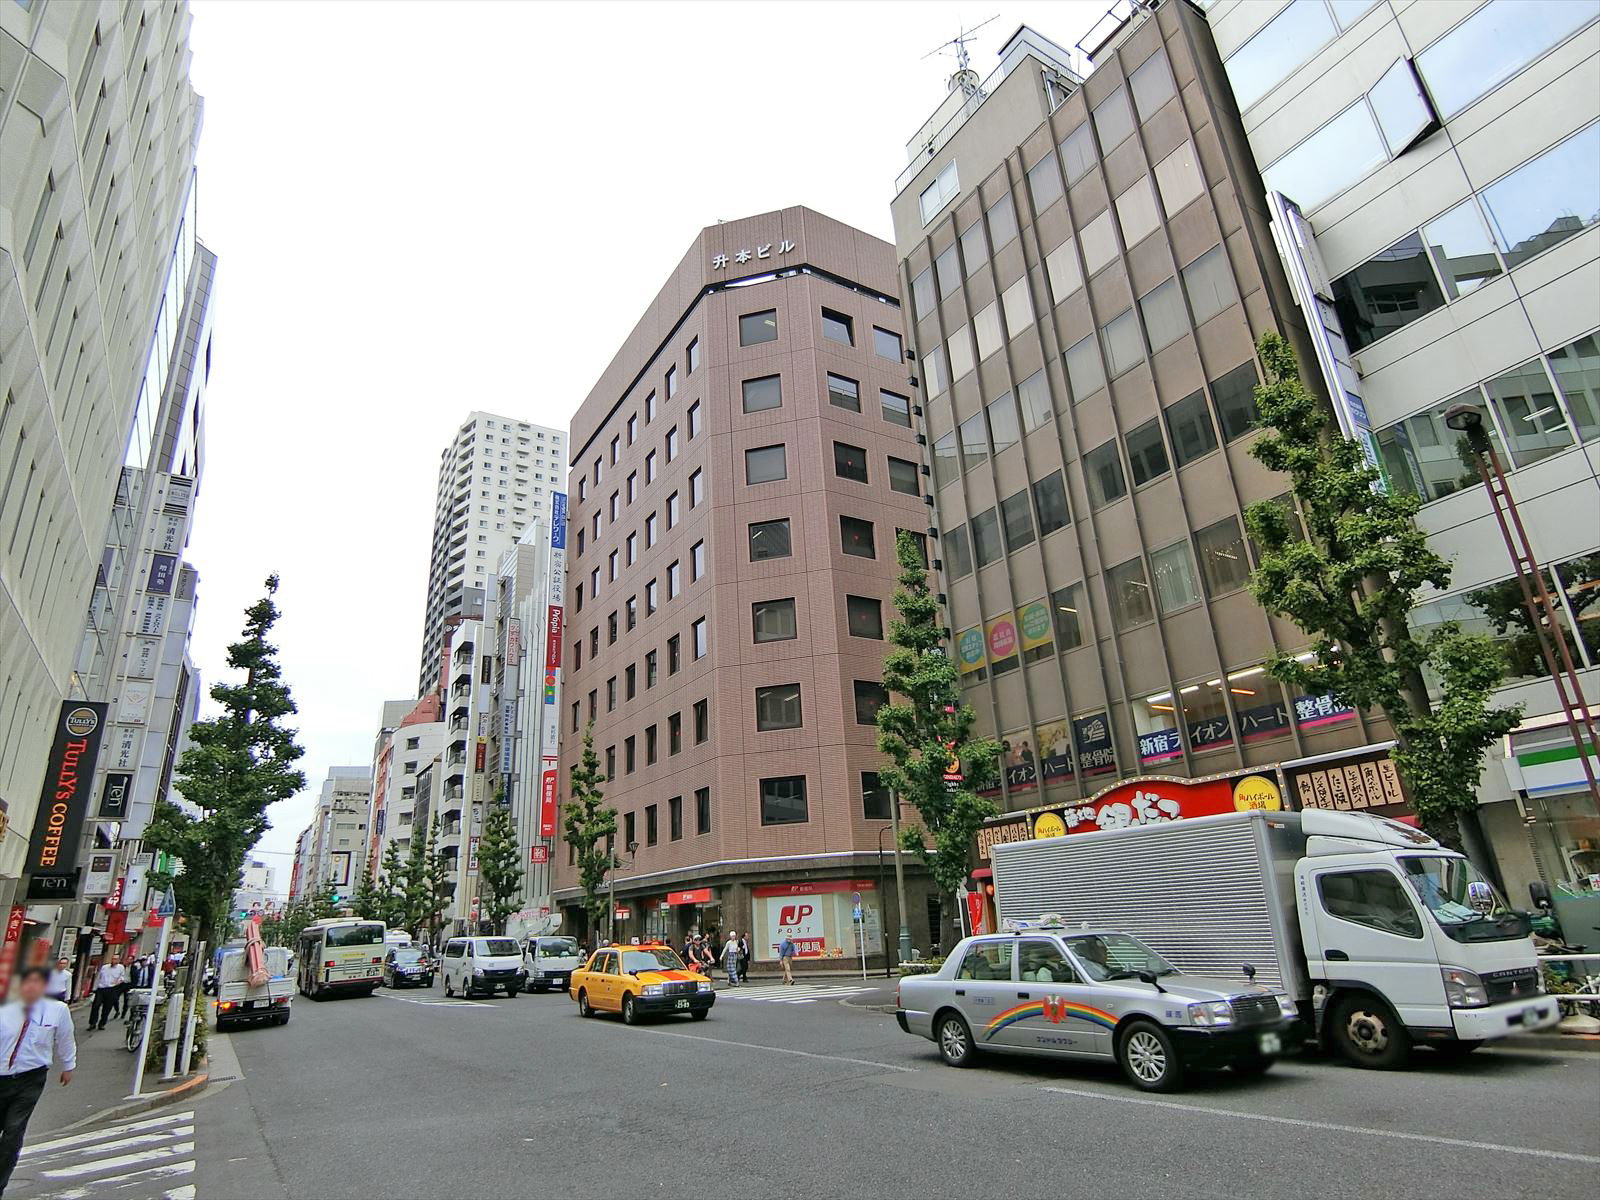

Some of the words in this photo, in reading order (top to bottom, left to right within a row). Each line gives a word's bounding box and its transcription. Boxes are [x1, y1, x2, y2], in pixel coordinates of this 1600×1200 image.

[713, 241, 795, 270] 升本ビル
[56, 738, 88, 801] TULLY'S
[118, 740, 132, 768] 清光社
[40, 802, 68, 868] COFFEE
